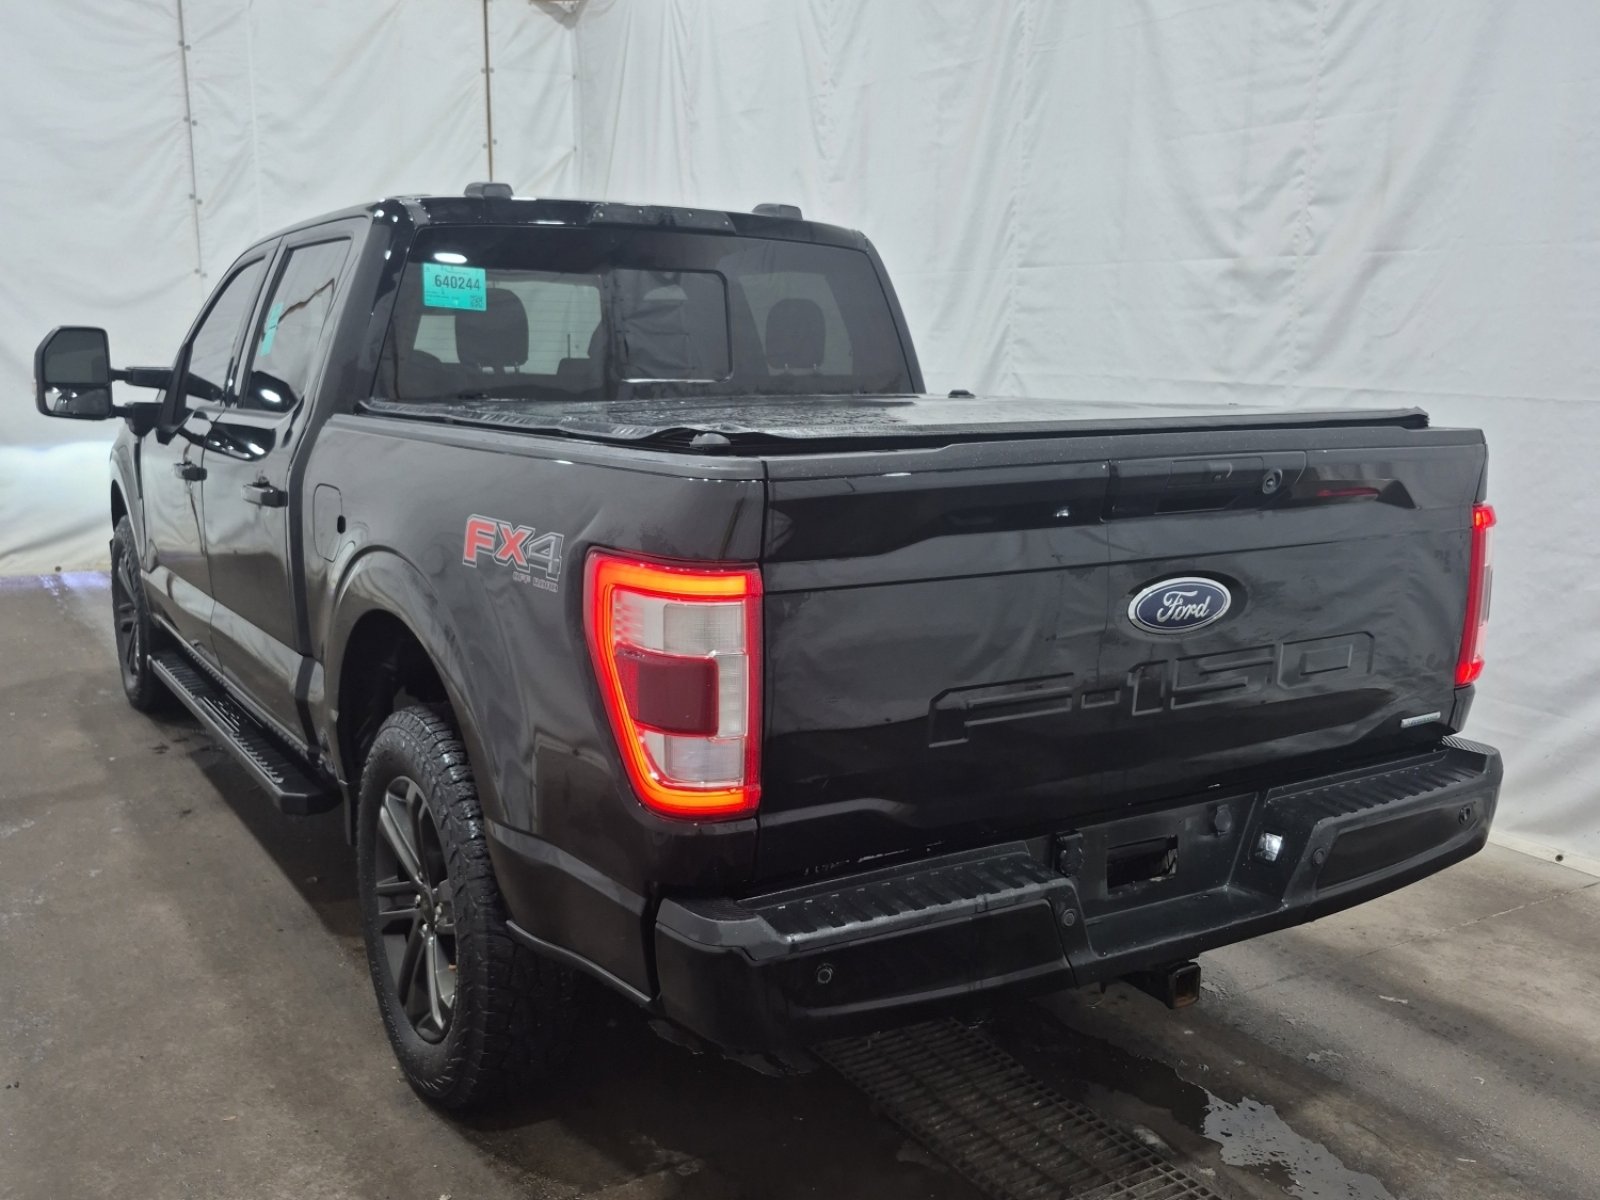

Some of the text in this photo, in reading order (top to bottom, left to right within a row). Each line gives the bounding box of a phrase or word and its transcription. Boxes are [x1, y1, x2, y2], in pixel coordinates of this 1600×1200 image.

[434, 274, 481, 291] 640244
[462, 513, 564, 582] FX4
[1156, 590, 1211, 623] Ford
[928, 630, 1376, 749] F-150
